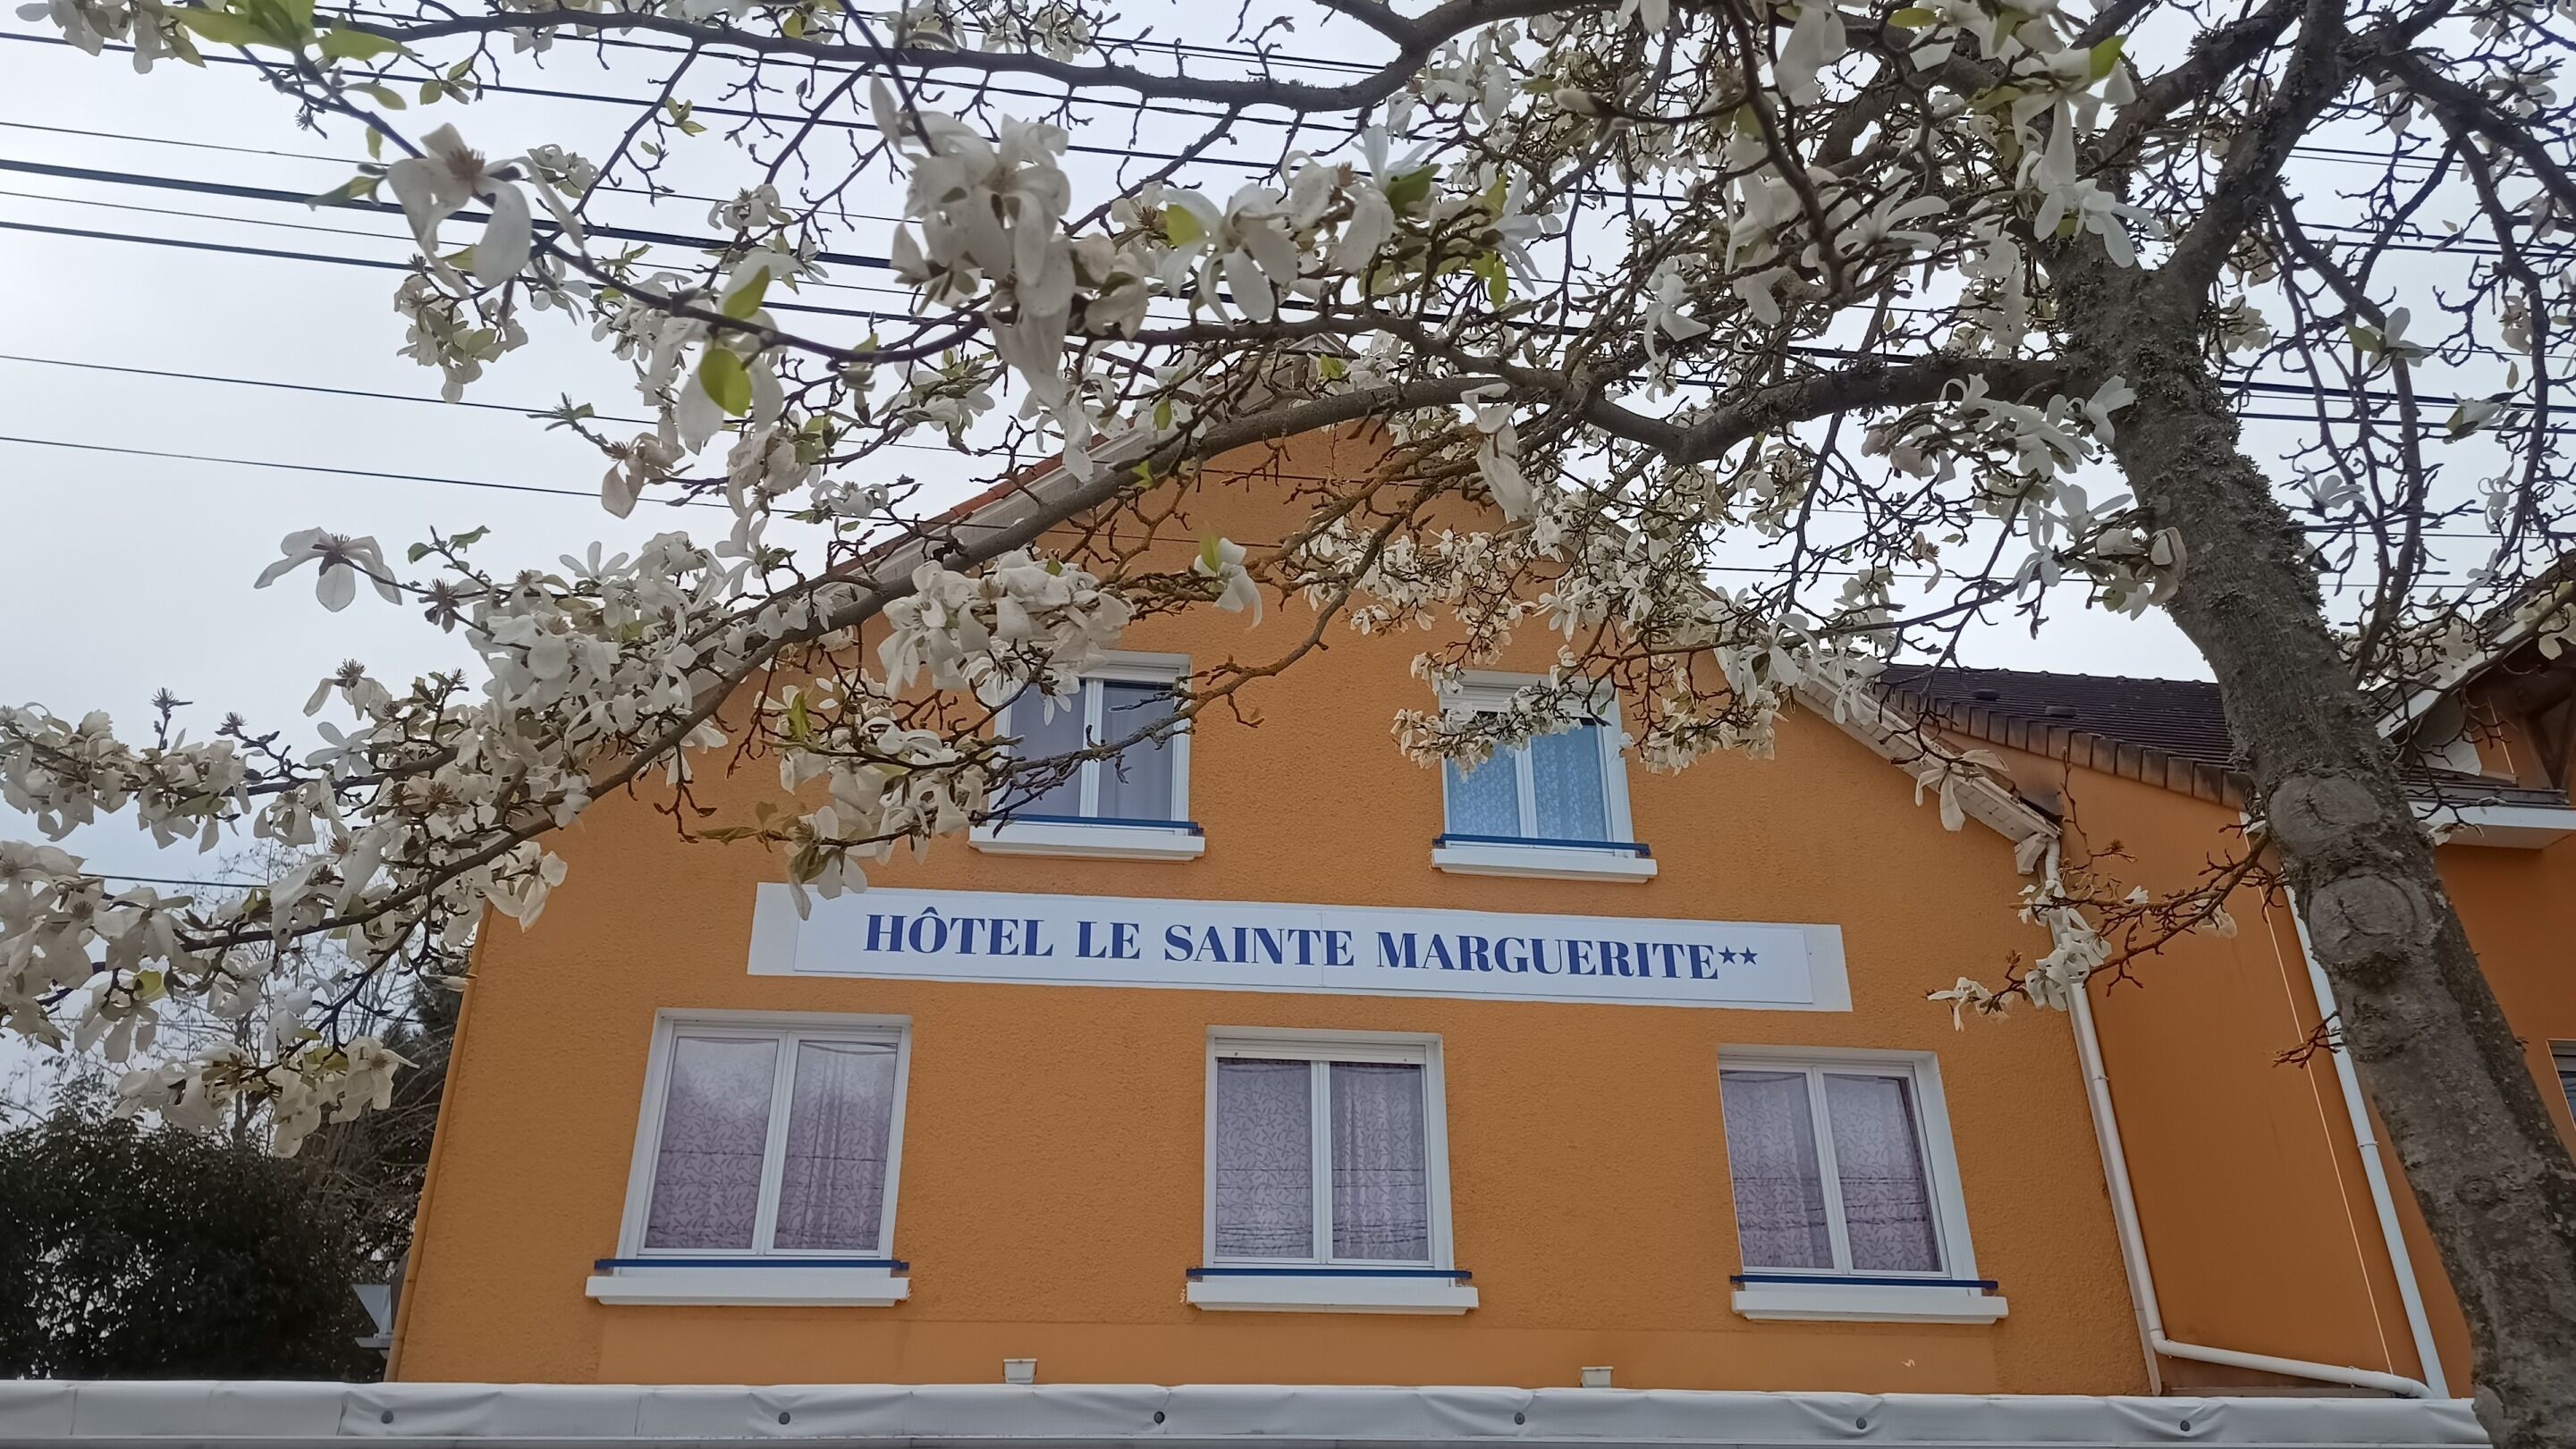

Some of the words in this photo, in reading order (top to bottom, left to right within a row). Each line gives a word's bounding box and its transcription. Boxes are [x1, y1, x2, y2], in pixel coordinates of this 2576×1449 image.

[864, 906, 1054, 957] HÔTEL
[1076, 921, 1141, 960] LE
[1163, 923, 1355, 966] SAINTE
